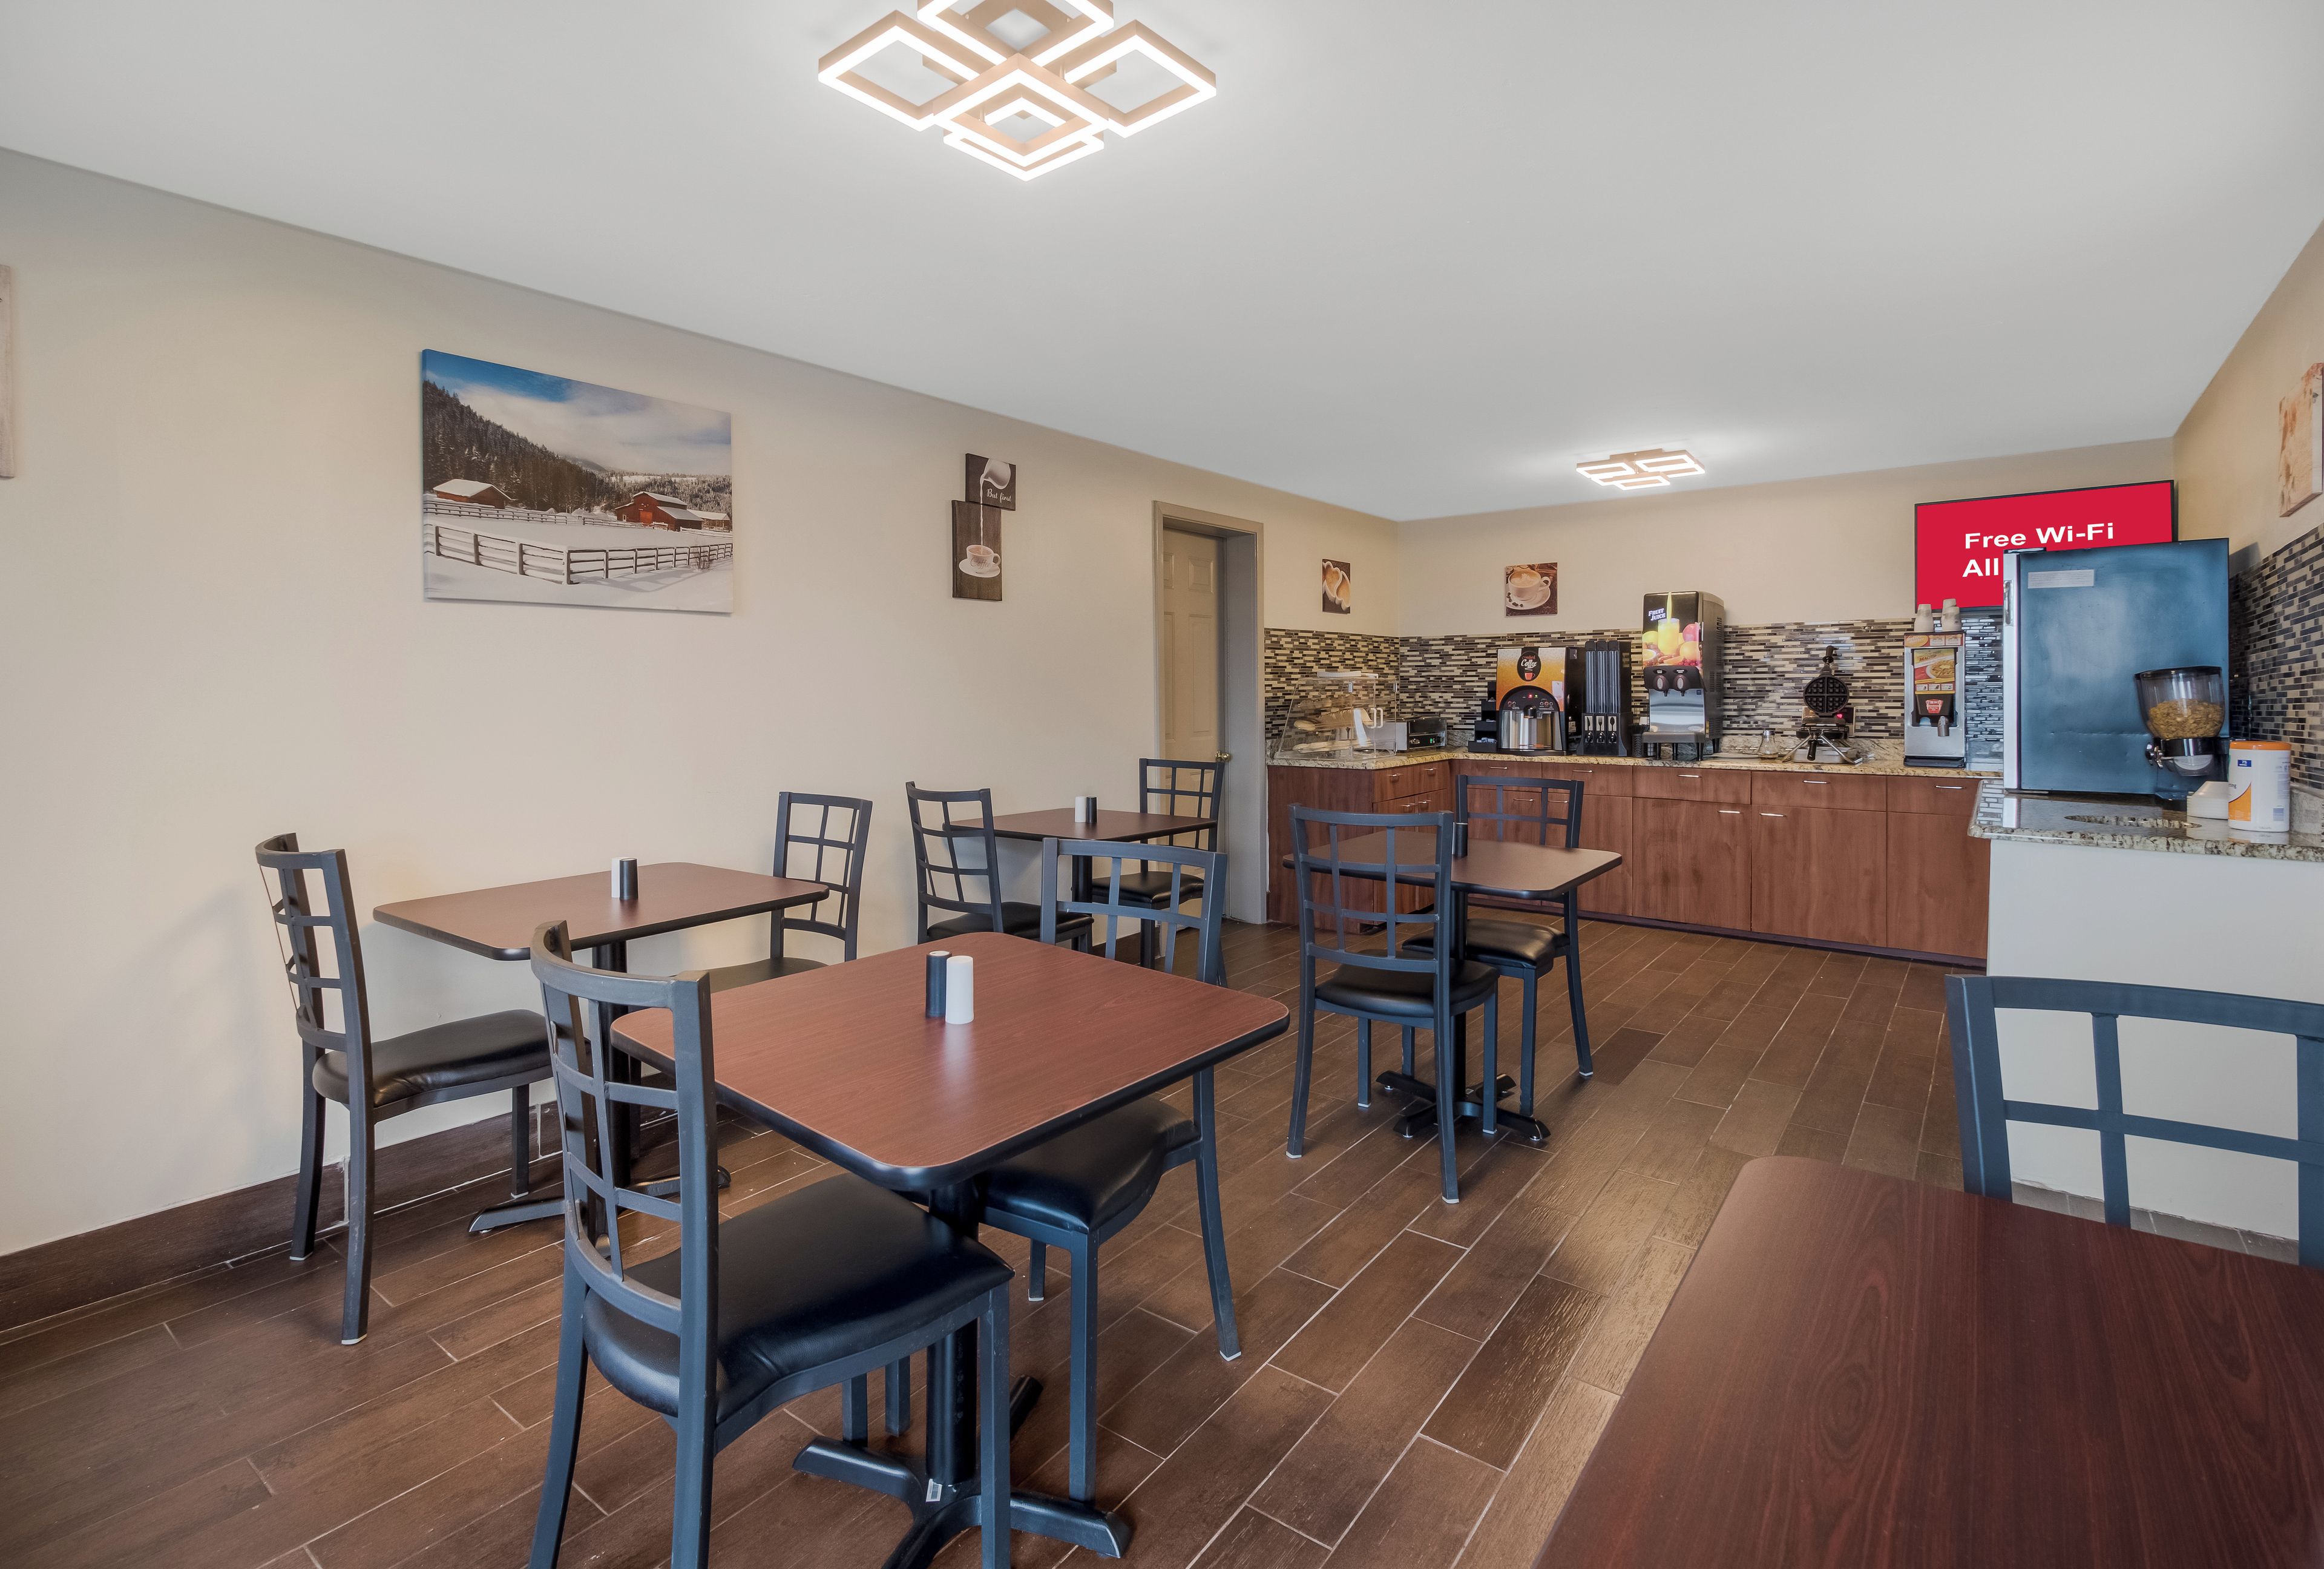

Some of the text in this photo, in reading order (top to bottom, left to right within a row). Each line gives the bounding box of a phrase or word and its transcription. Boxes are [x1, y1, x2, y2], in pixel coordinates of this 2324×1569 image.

[987, 488, 1011, 503] But first
[1965, 522, 2113, 549] Free Wi-Fi
[970, 556, 990, 569] Coffee
[1962, 558, 1999, 577] All
[1648, 608, 1664, 616] FRUIT
[1650, 613, 1666, 621] JUICE
[1521, 659, 1537, 668] Coffee
